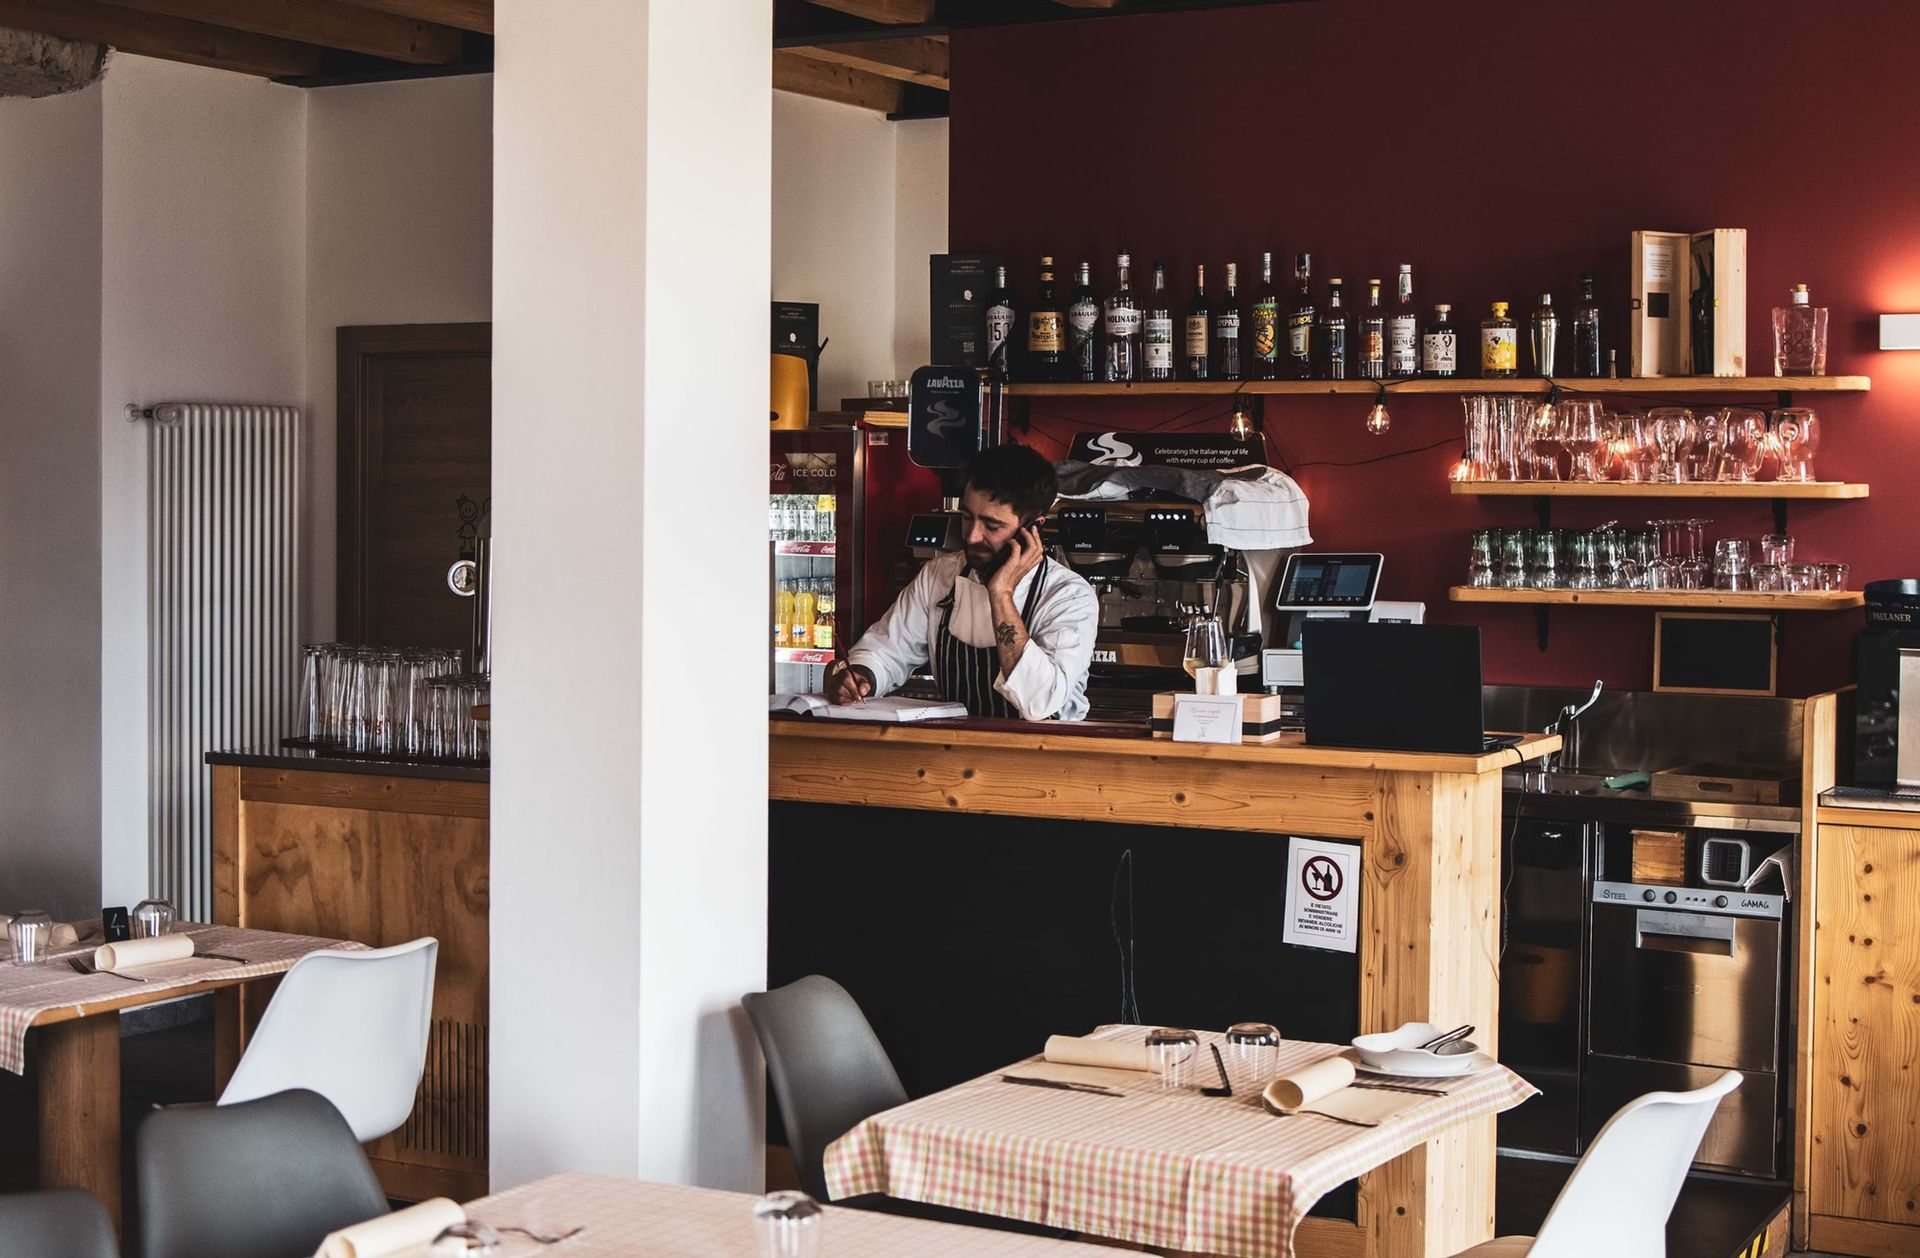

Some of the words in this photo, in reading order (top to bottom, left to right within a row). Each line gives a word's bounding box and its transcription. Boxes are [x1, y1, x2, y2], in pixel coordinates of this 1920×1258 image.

[1107, 315, 1138, 324] MOLINARI
[926, 376, 965, 389] LAVAZZA
[1154, 448, 1189, 457] Celebrating
[792, 468, 808, 478] ICE
[811, 468, 837, 478] COLD
[1872, 611, 1912, 622] PAULANER
[110, 912, 126, 937] 4
